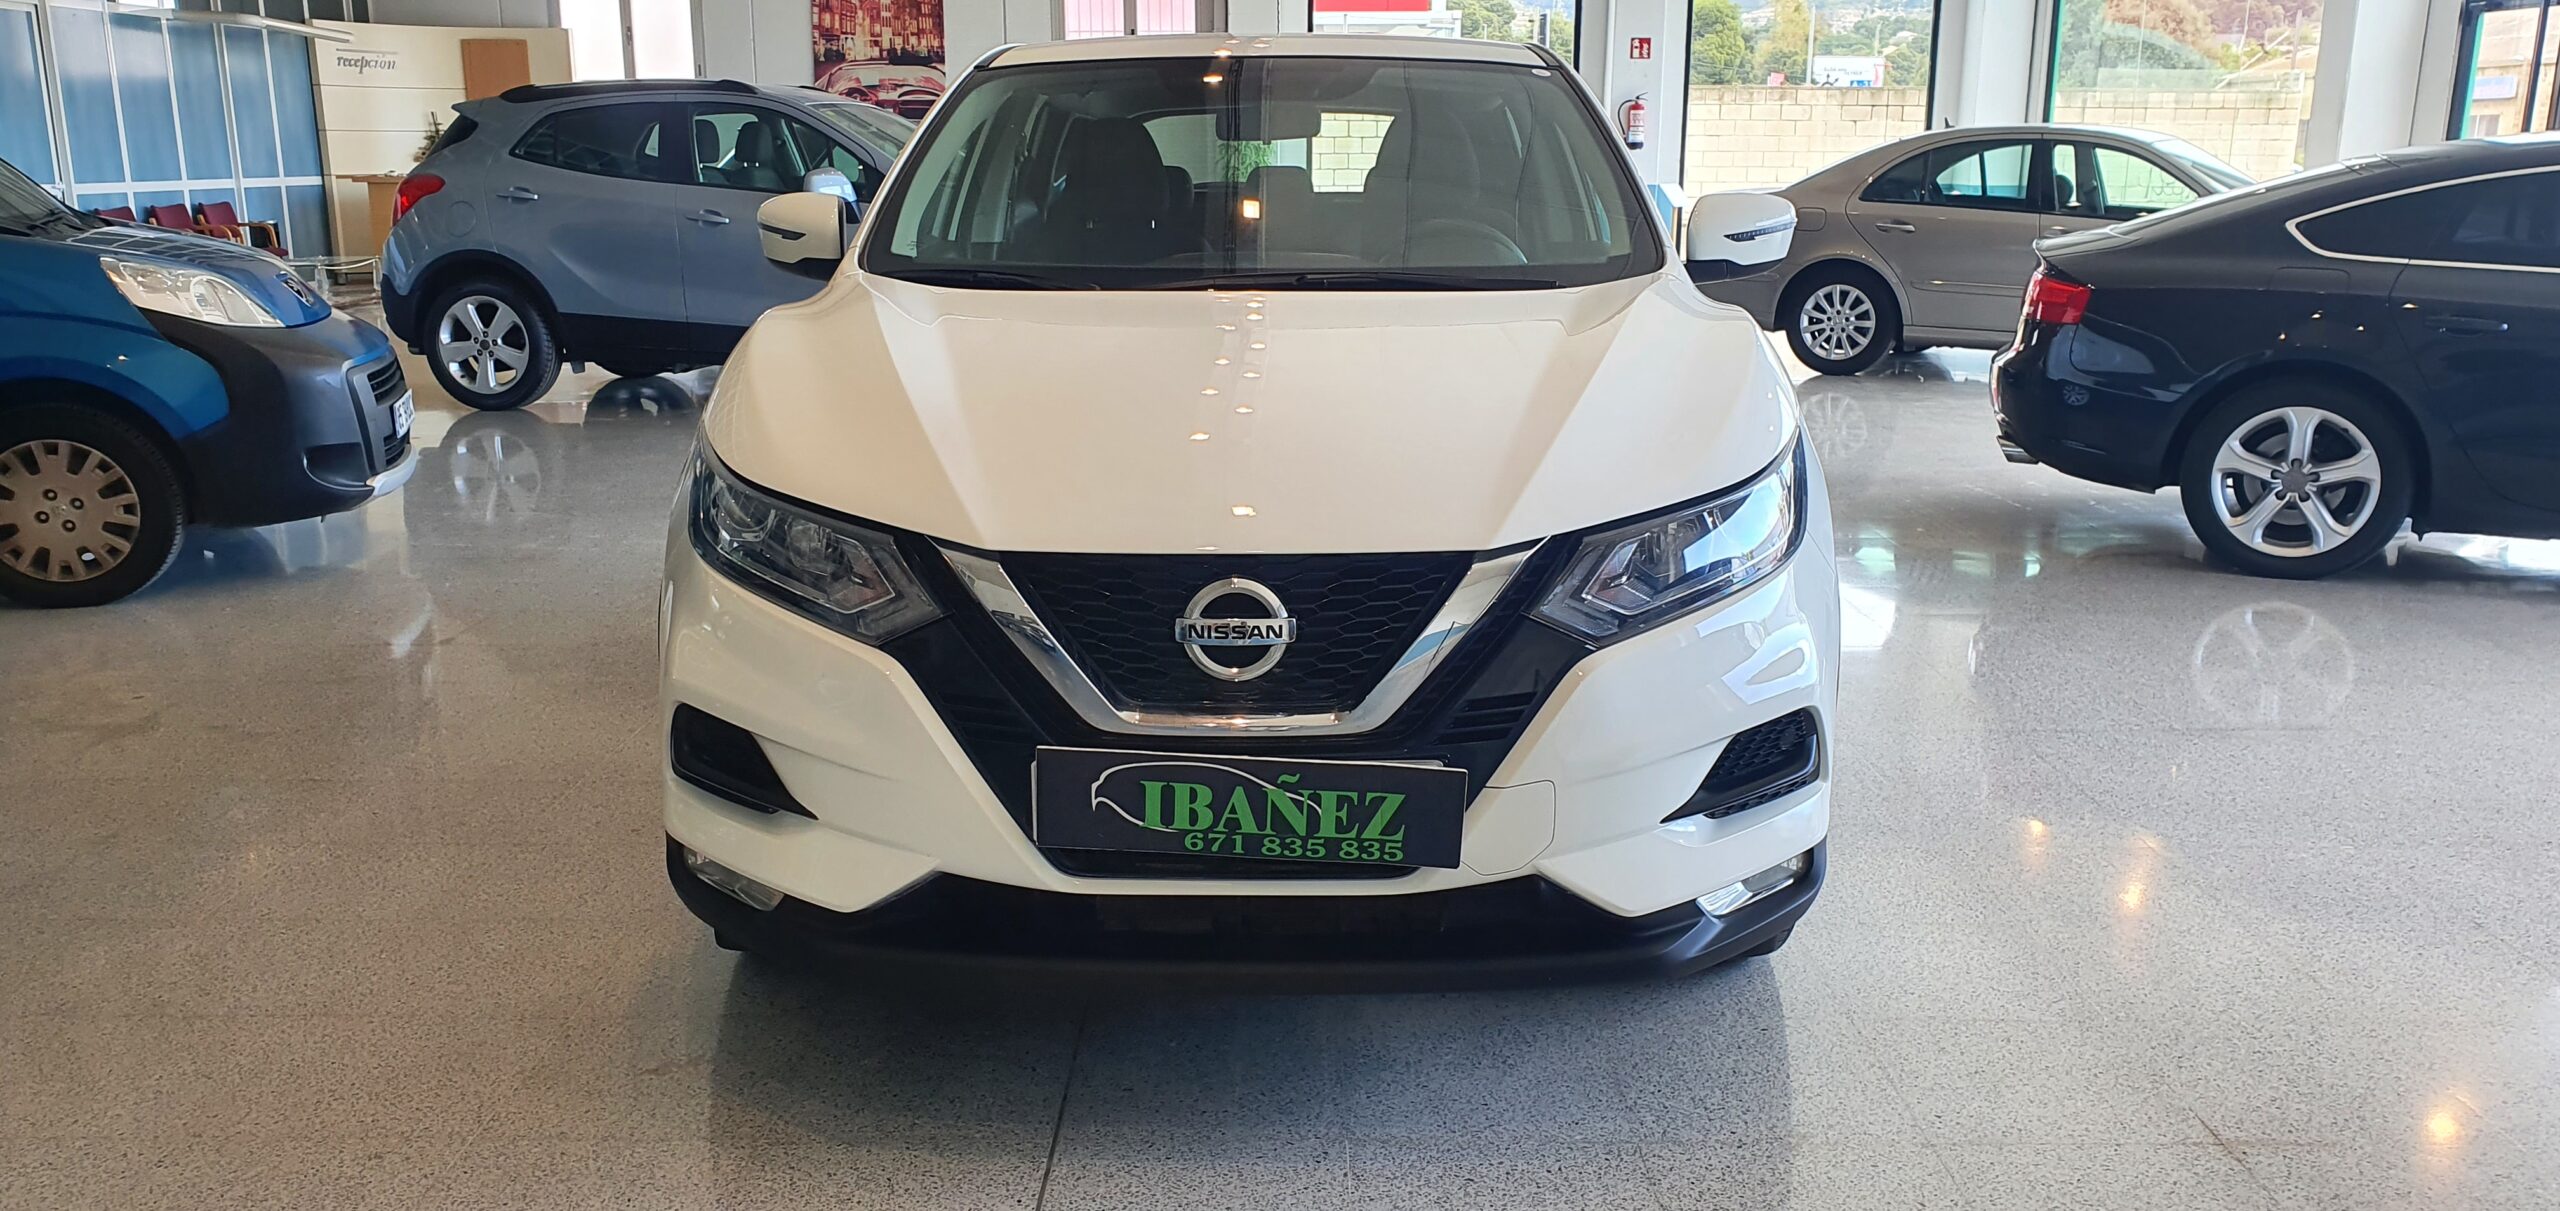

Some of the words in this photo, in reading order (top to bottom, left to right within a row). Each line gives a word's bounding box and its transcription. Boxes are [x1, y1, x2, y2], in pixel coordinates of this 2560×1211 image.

[1187, 624, 1283, 640] NISSAN
[1139, 773, 1406, 841] IBAÑEZ
[1183, 831, 1245, 855] 671
[1260, 836, 1327, 859] 835
[1338, 839, 1405, 862] 835
